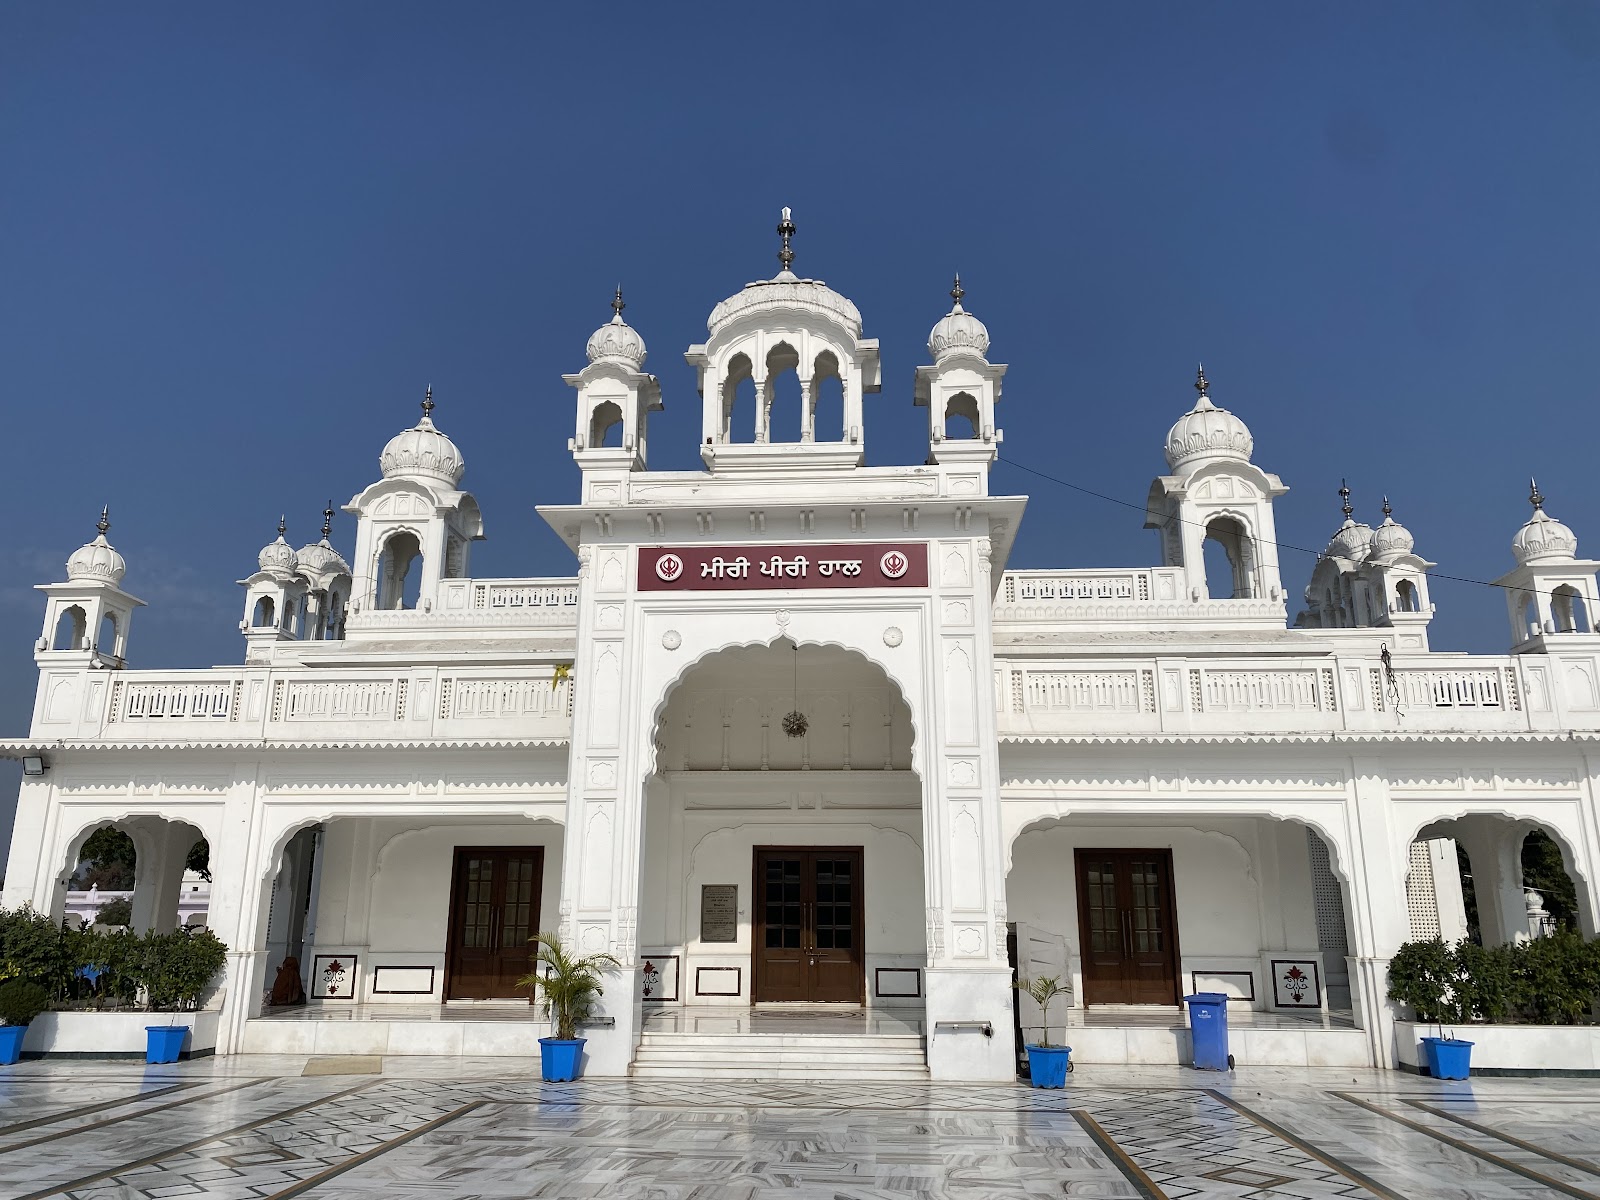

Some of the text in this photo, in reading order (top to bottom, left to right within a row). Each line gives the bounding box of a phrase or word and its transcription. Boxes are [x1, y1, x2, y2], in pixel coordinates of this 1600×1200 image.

[700, 555, 863, 578] ਮੀਰੀ ਪੀਰੀ ਹਾਲ
